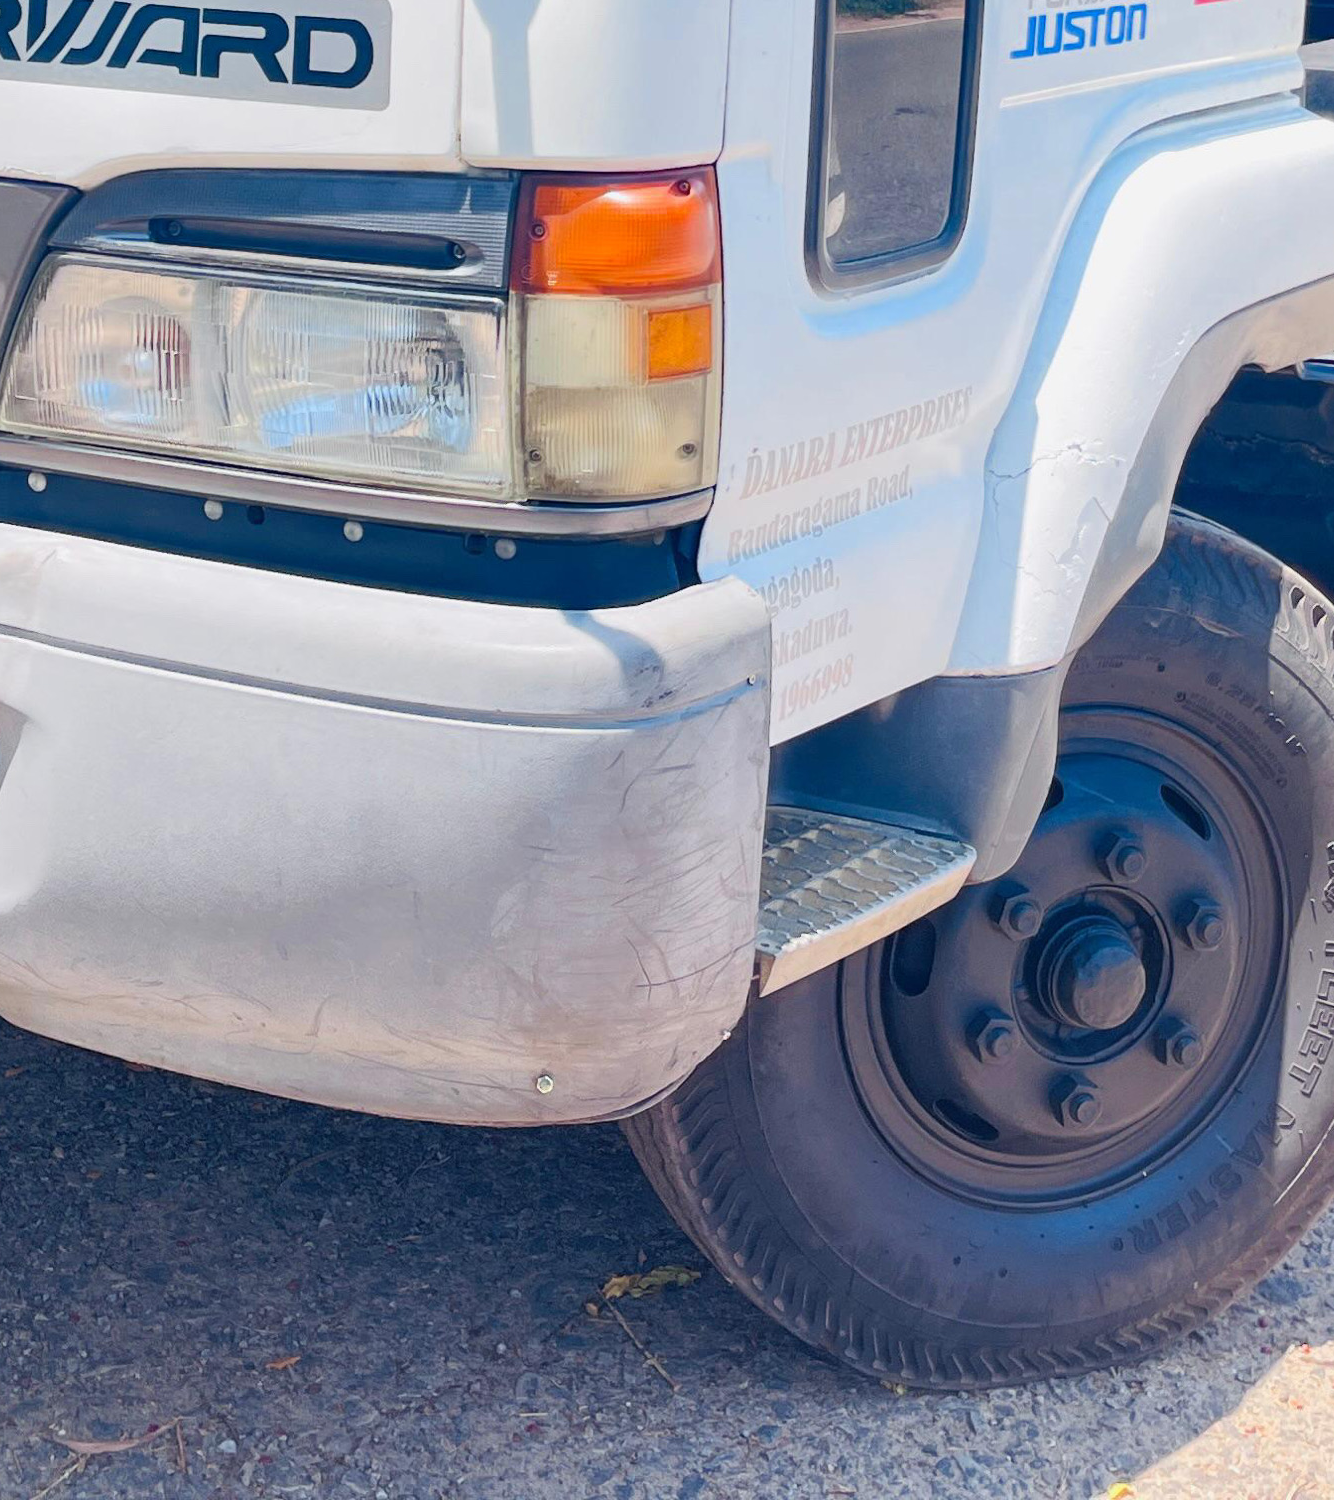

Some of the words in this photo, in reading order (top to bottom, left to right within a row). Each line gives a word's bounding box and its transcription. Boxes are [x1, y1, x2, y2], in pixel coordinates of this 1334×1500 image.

[1009, 2, 1148, 60] JUSTON
[727, 487, 861, 566] Bandaragama
[865, 464, 914, 513] Road,
